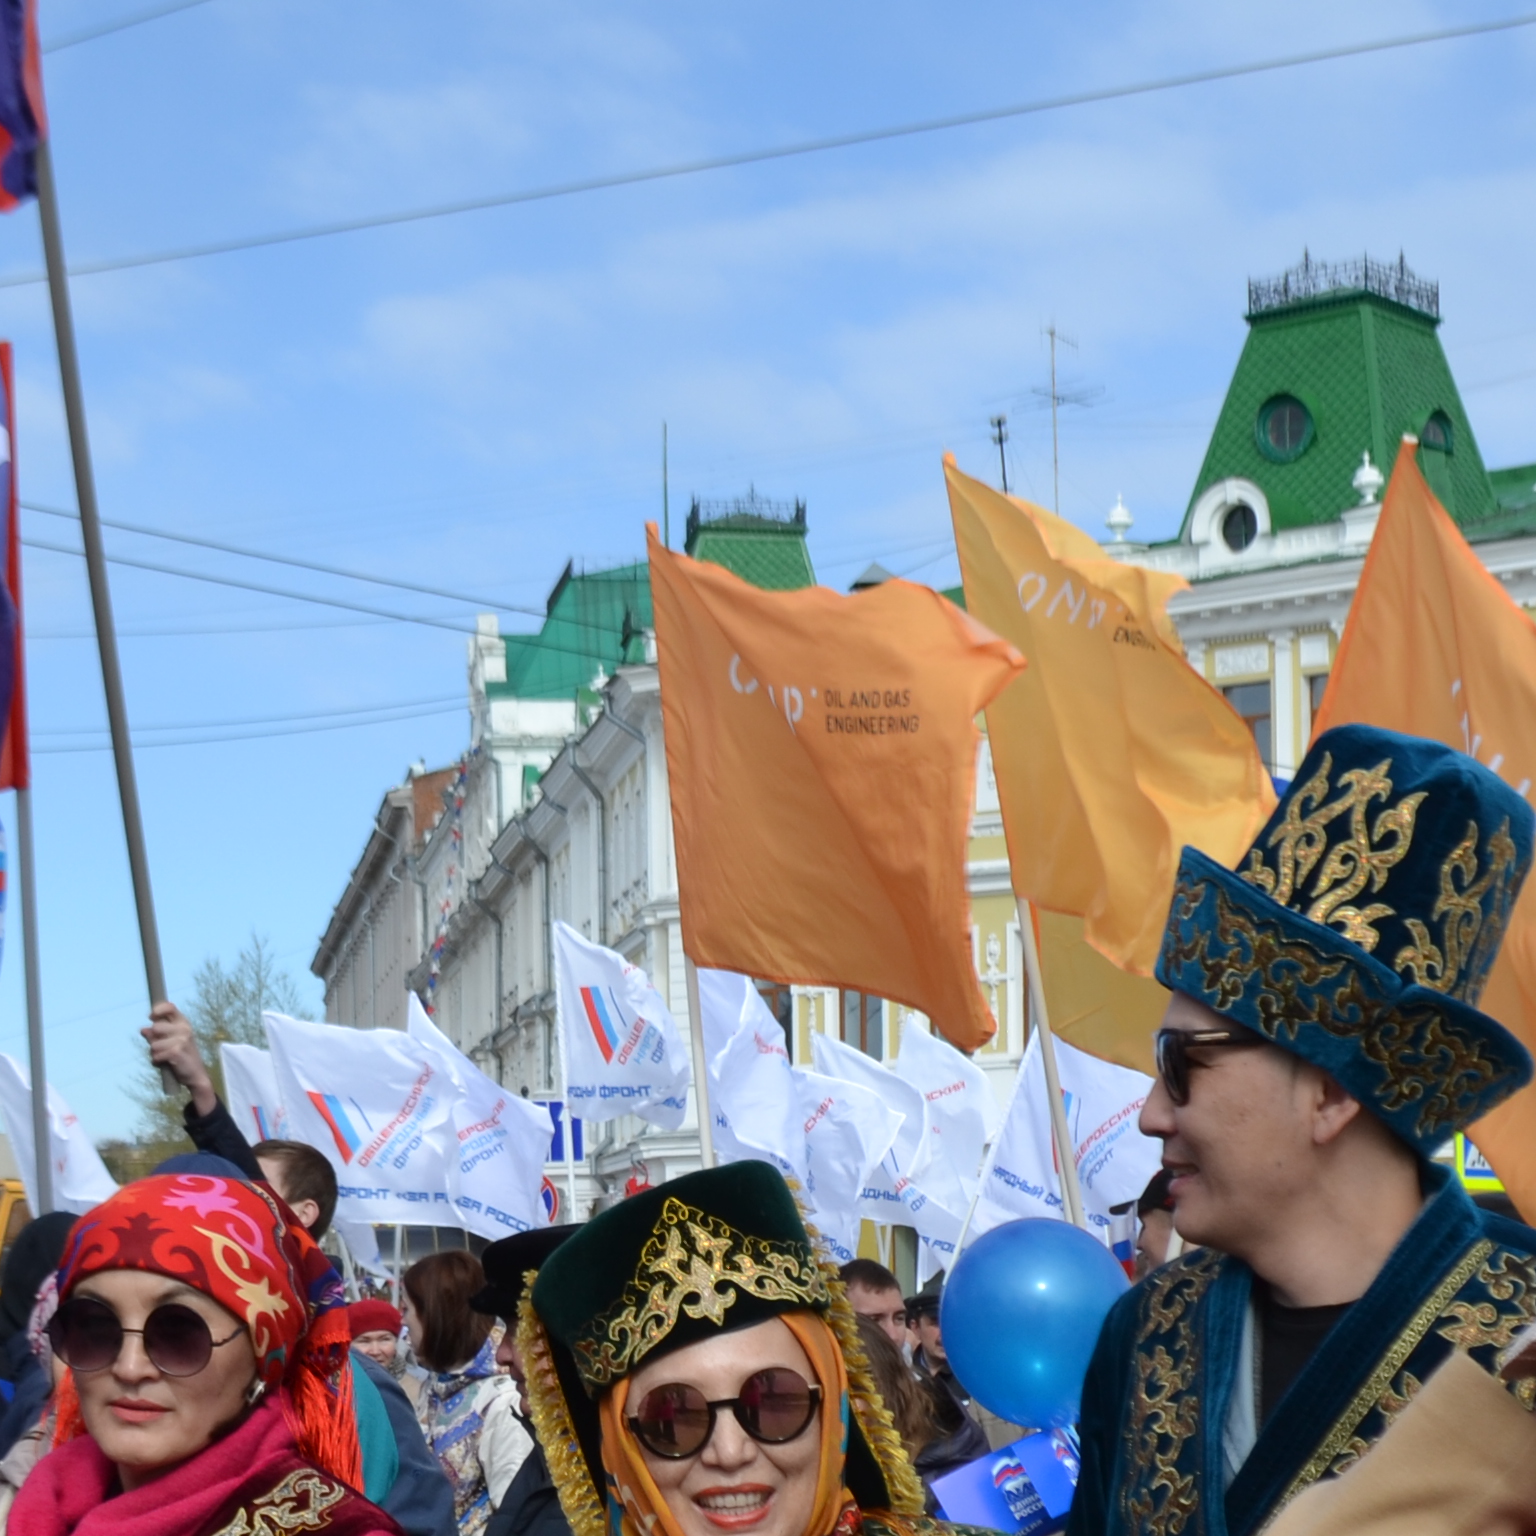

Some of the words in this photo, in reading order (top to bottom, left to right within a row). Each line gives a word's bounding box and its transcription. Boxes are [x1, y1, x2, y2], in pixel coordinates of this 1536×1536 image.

[824, 689, 845, 708] OIL
[850, 690, 881, 708] AND
[884, 688, 912, 708] GAS
[825, 714, 920, 734] ENGINEERING
[599, 1084, 652, 1100] ФРОНТ
